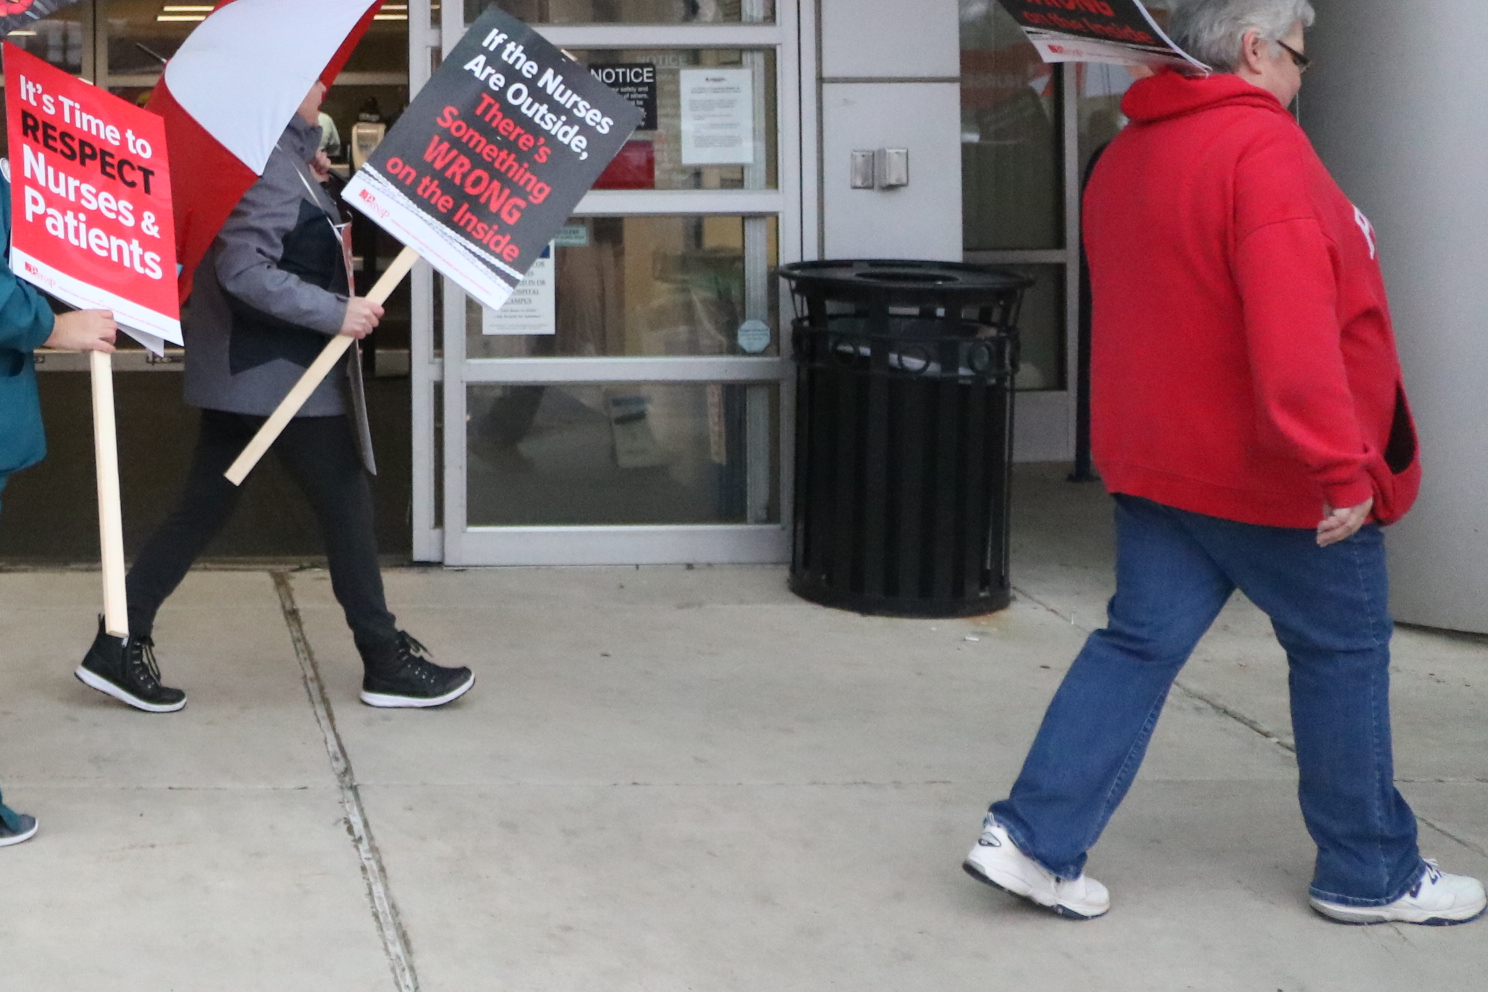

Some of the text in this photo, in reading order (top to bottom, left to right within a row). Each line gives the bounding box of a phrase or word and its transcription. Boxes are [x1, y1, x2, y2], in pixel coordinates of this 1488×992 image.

[19, 74, 152, 160] It's Time to
[464, 53, 589, 161] Are Outside,
[481, 27, 508, 49] If
[500, 39, 540, 80] the
[537, 66, 614, 136] Nurses
[590, 67, 654, 83] NOTICE
[21, 109, 155, 196] RESPECT
[435, 105, 553, 205] Something
[473, 92, 552, 165] There's
[22, 143, 161, 239] Nurses &
[385, 155, 417, 186] on
[415, 173, 456, 214] the
[452, 201, 520, 263] Inside
[421, 134, 527, 227] WRONG
[24, 185, 164, 280] Patients
